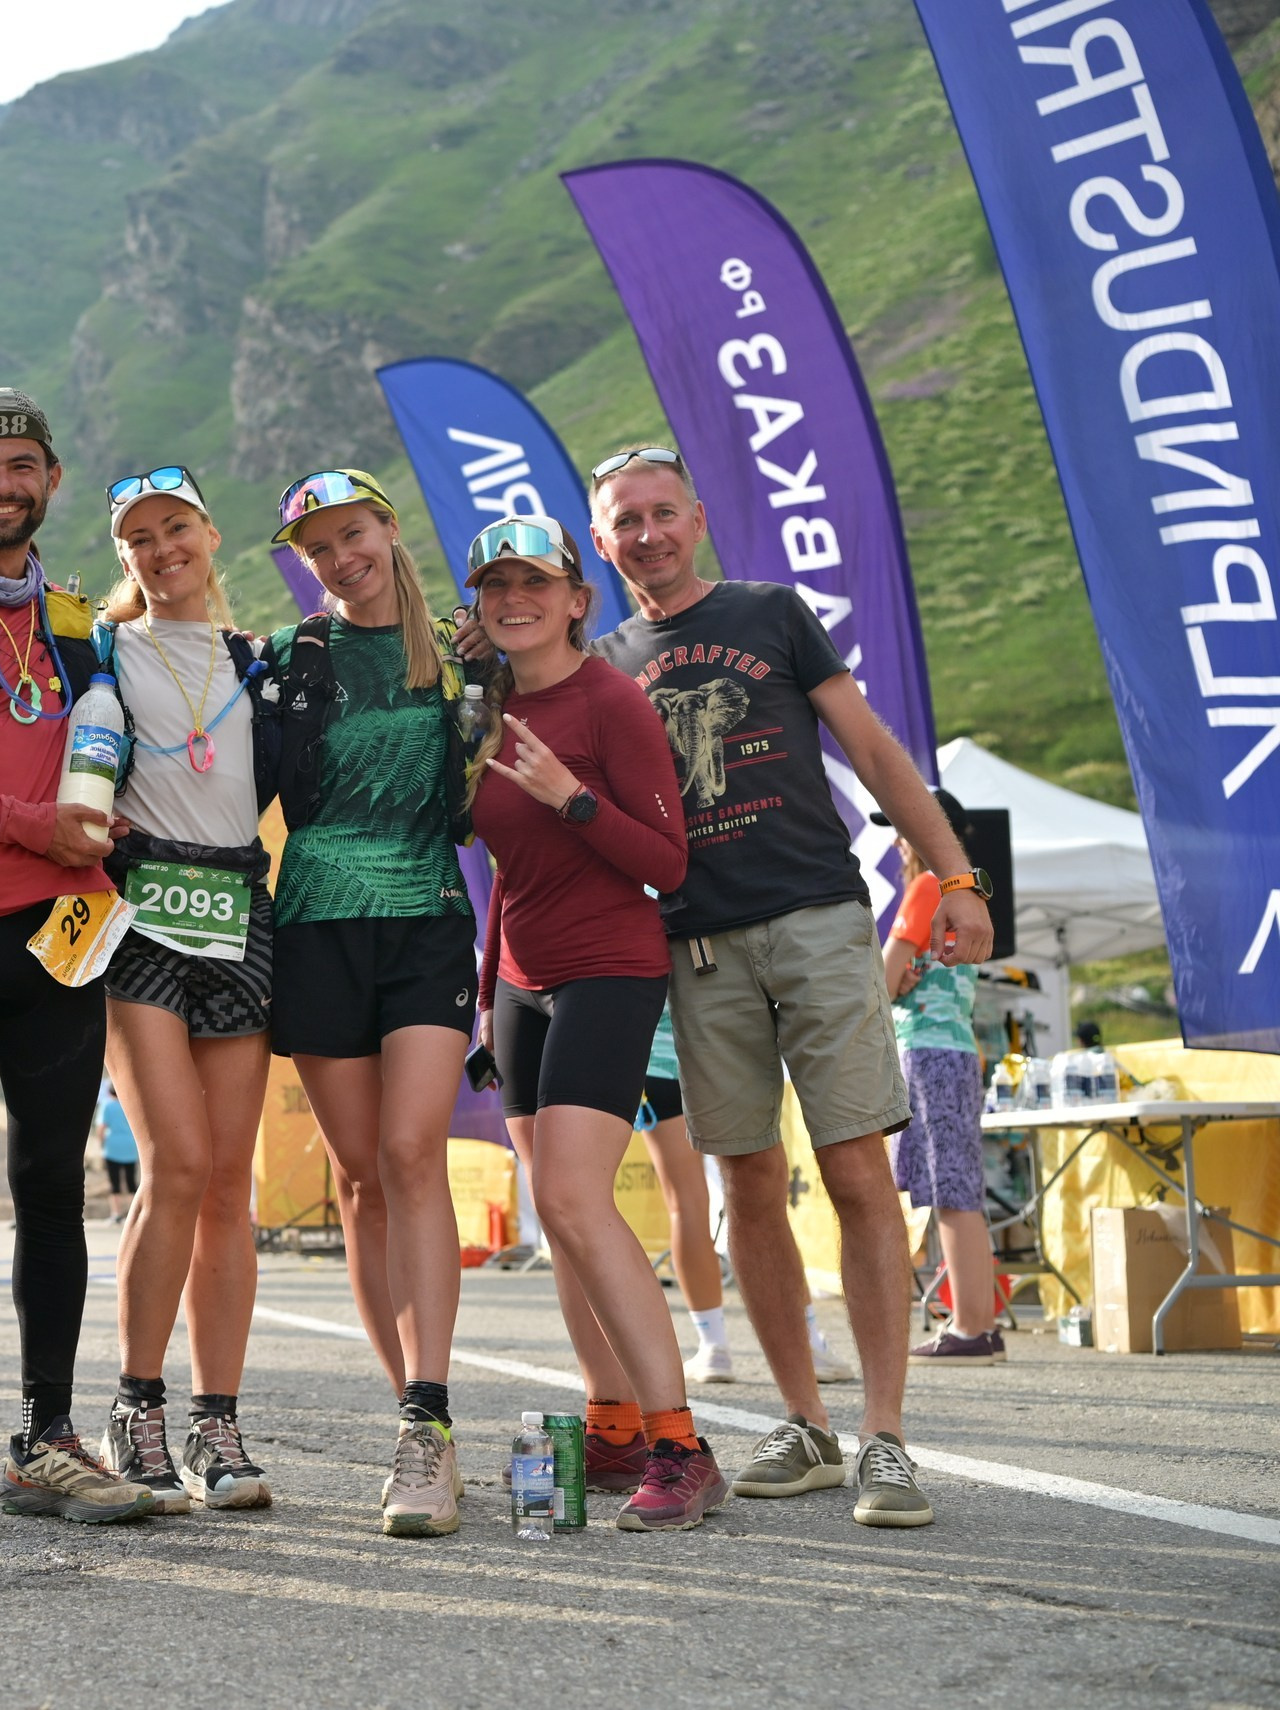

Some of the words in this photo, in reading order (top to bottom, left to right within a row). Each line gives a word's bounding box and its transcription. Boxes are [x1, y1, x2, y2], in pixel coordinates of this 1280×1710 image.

[636, 643, 771, 691] NDCRAFTED
[740, 740, 770, 755] 1975
[686, 812, 713, 827] SIVE
[719, 796, 783, 819] GARMENTS
[686, 825, 714, 840] IMITED
[718, 814, 758, 831] EDITION
[693, 833, 730, 848] CLOTHING
[140, 863, 160, 872] HEGET
[139, 883, 234, 922] 2093
[61, 897, 91, 947] 29
